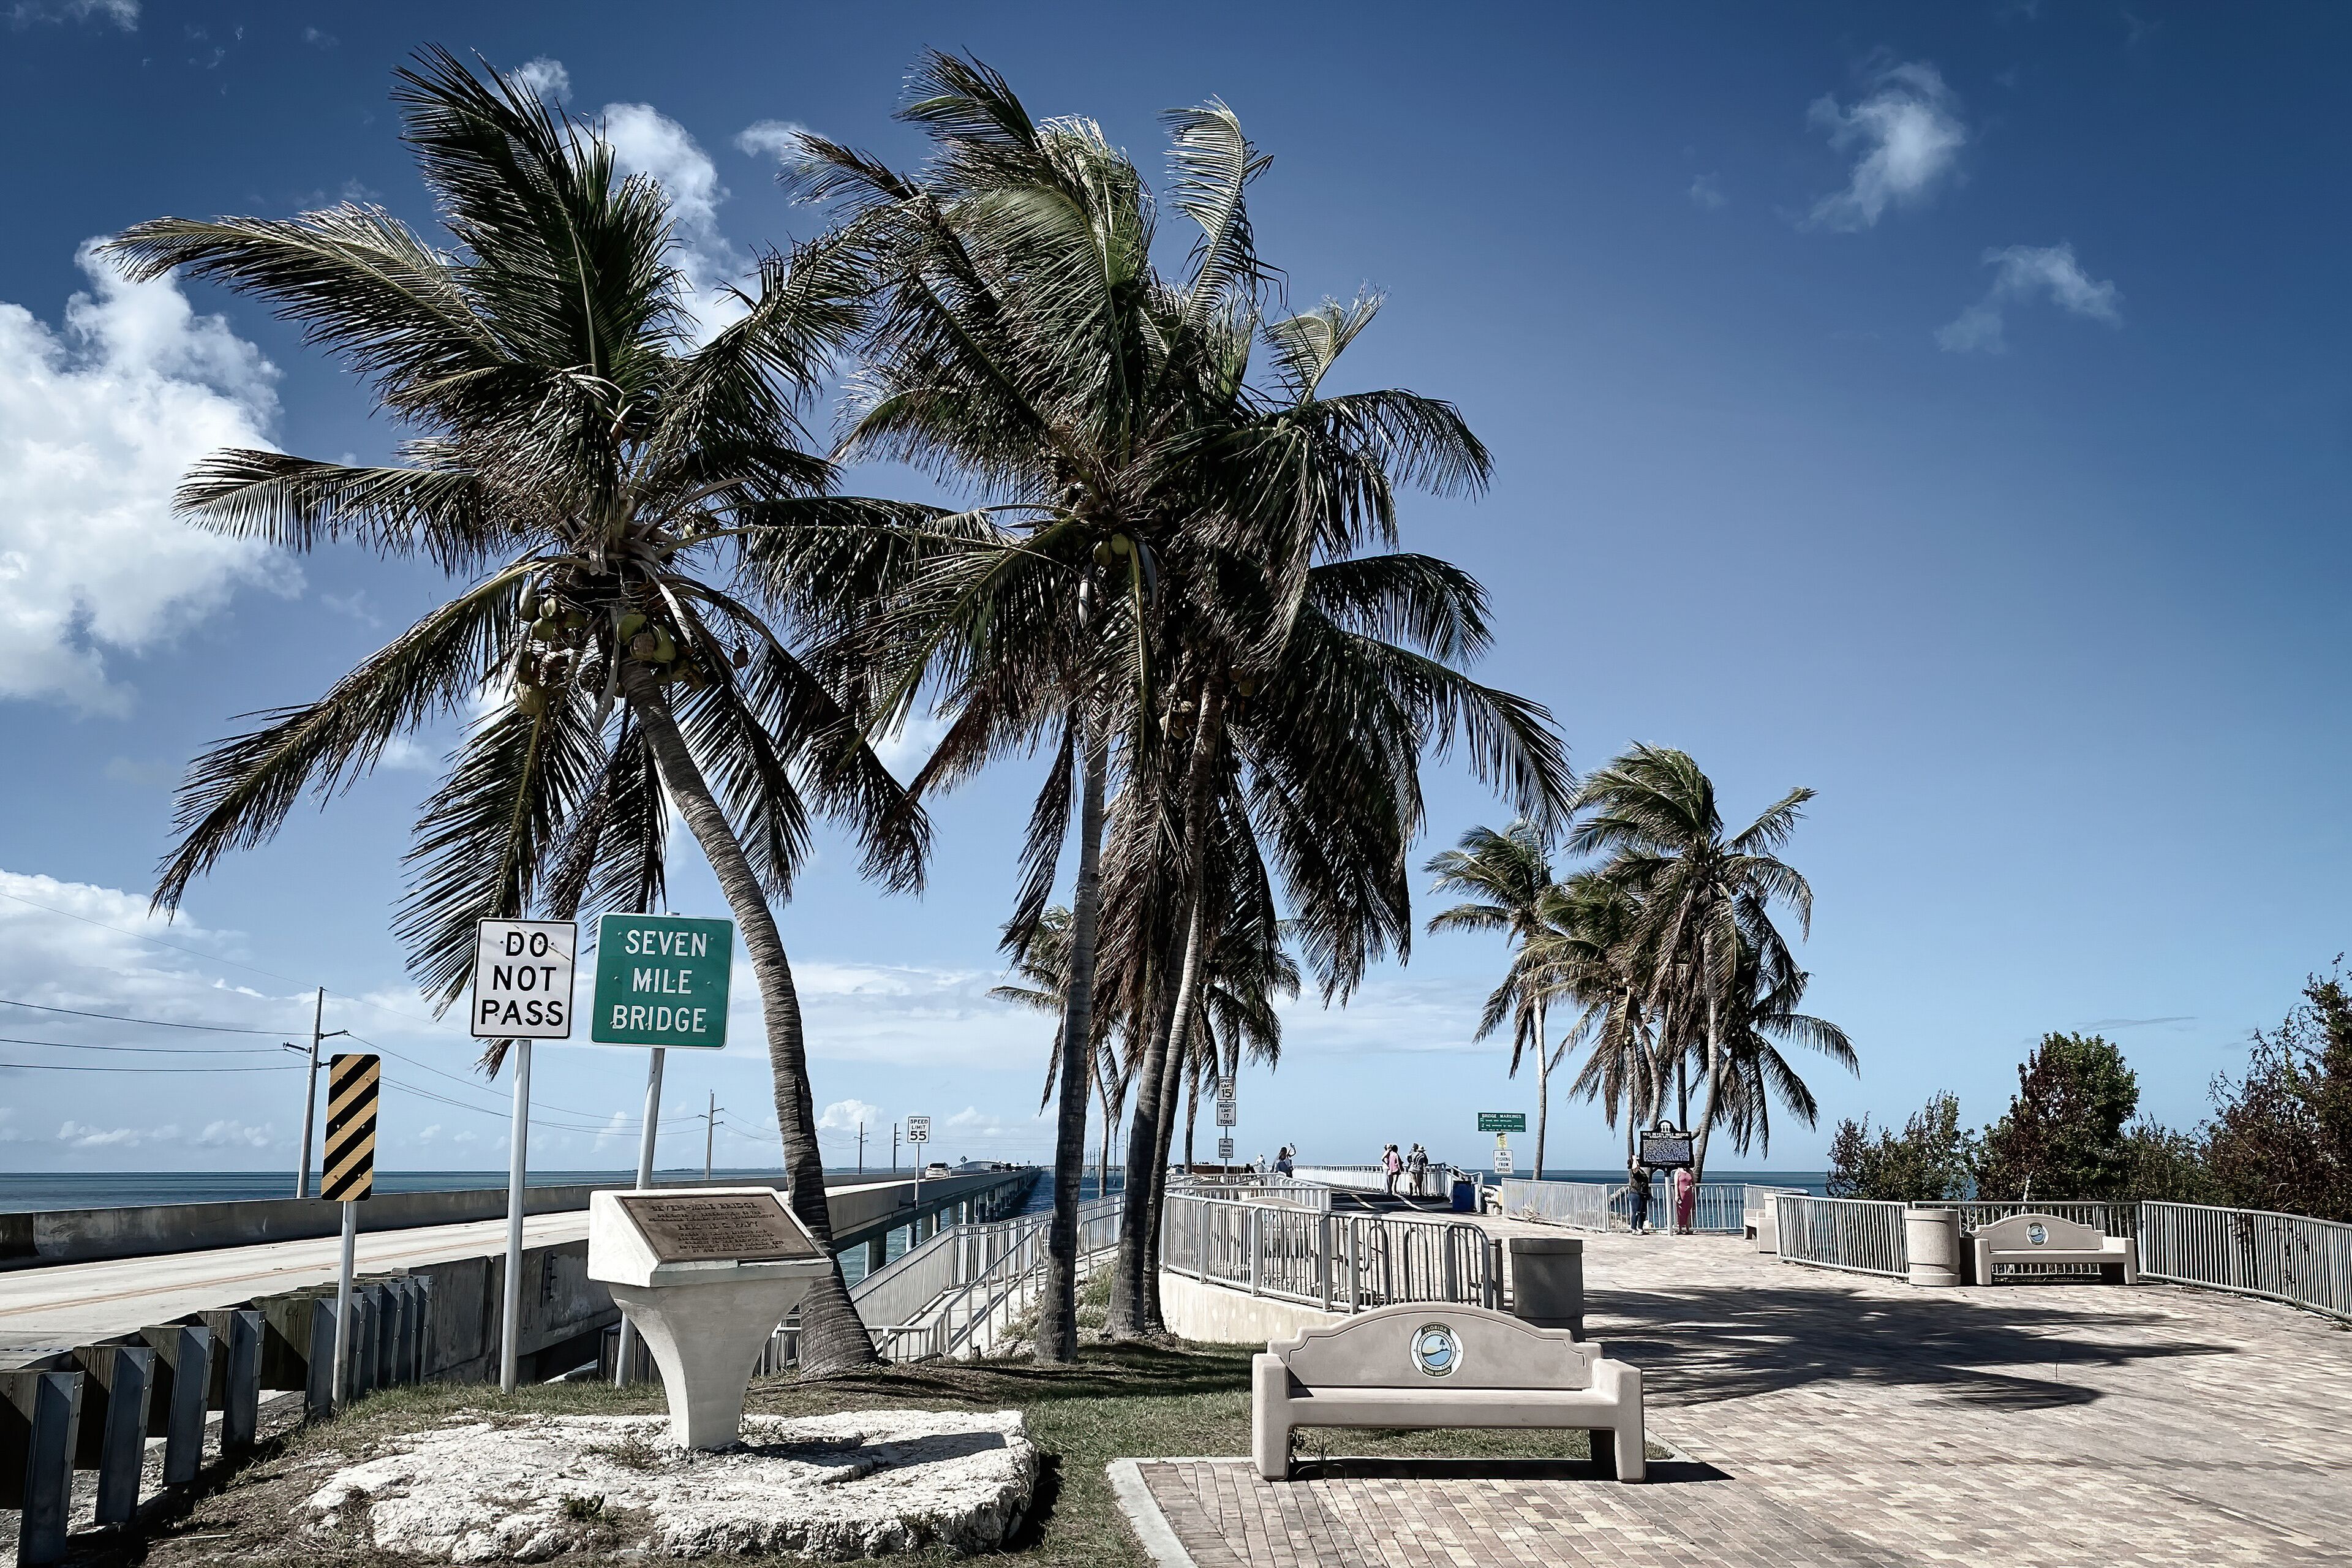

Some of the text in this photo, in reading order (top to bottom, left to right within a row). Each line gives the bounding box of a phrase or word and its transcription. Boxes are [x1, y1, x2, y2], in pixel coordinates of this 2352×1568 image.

[505, 931, 549, 958] DO
[625, 929, 707, 958] SEVEN
[492, 965, 557, 992] NOT
[632, 967, 693, 995] MILE
[480, 999, 564, 1027] PASS
[612, 1005, 707, 1033] BRIDGE
[1221, 1089, 1232, 1098] 15
[910, 1131, 927, 1140] 55
